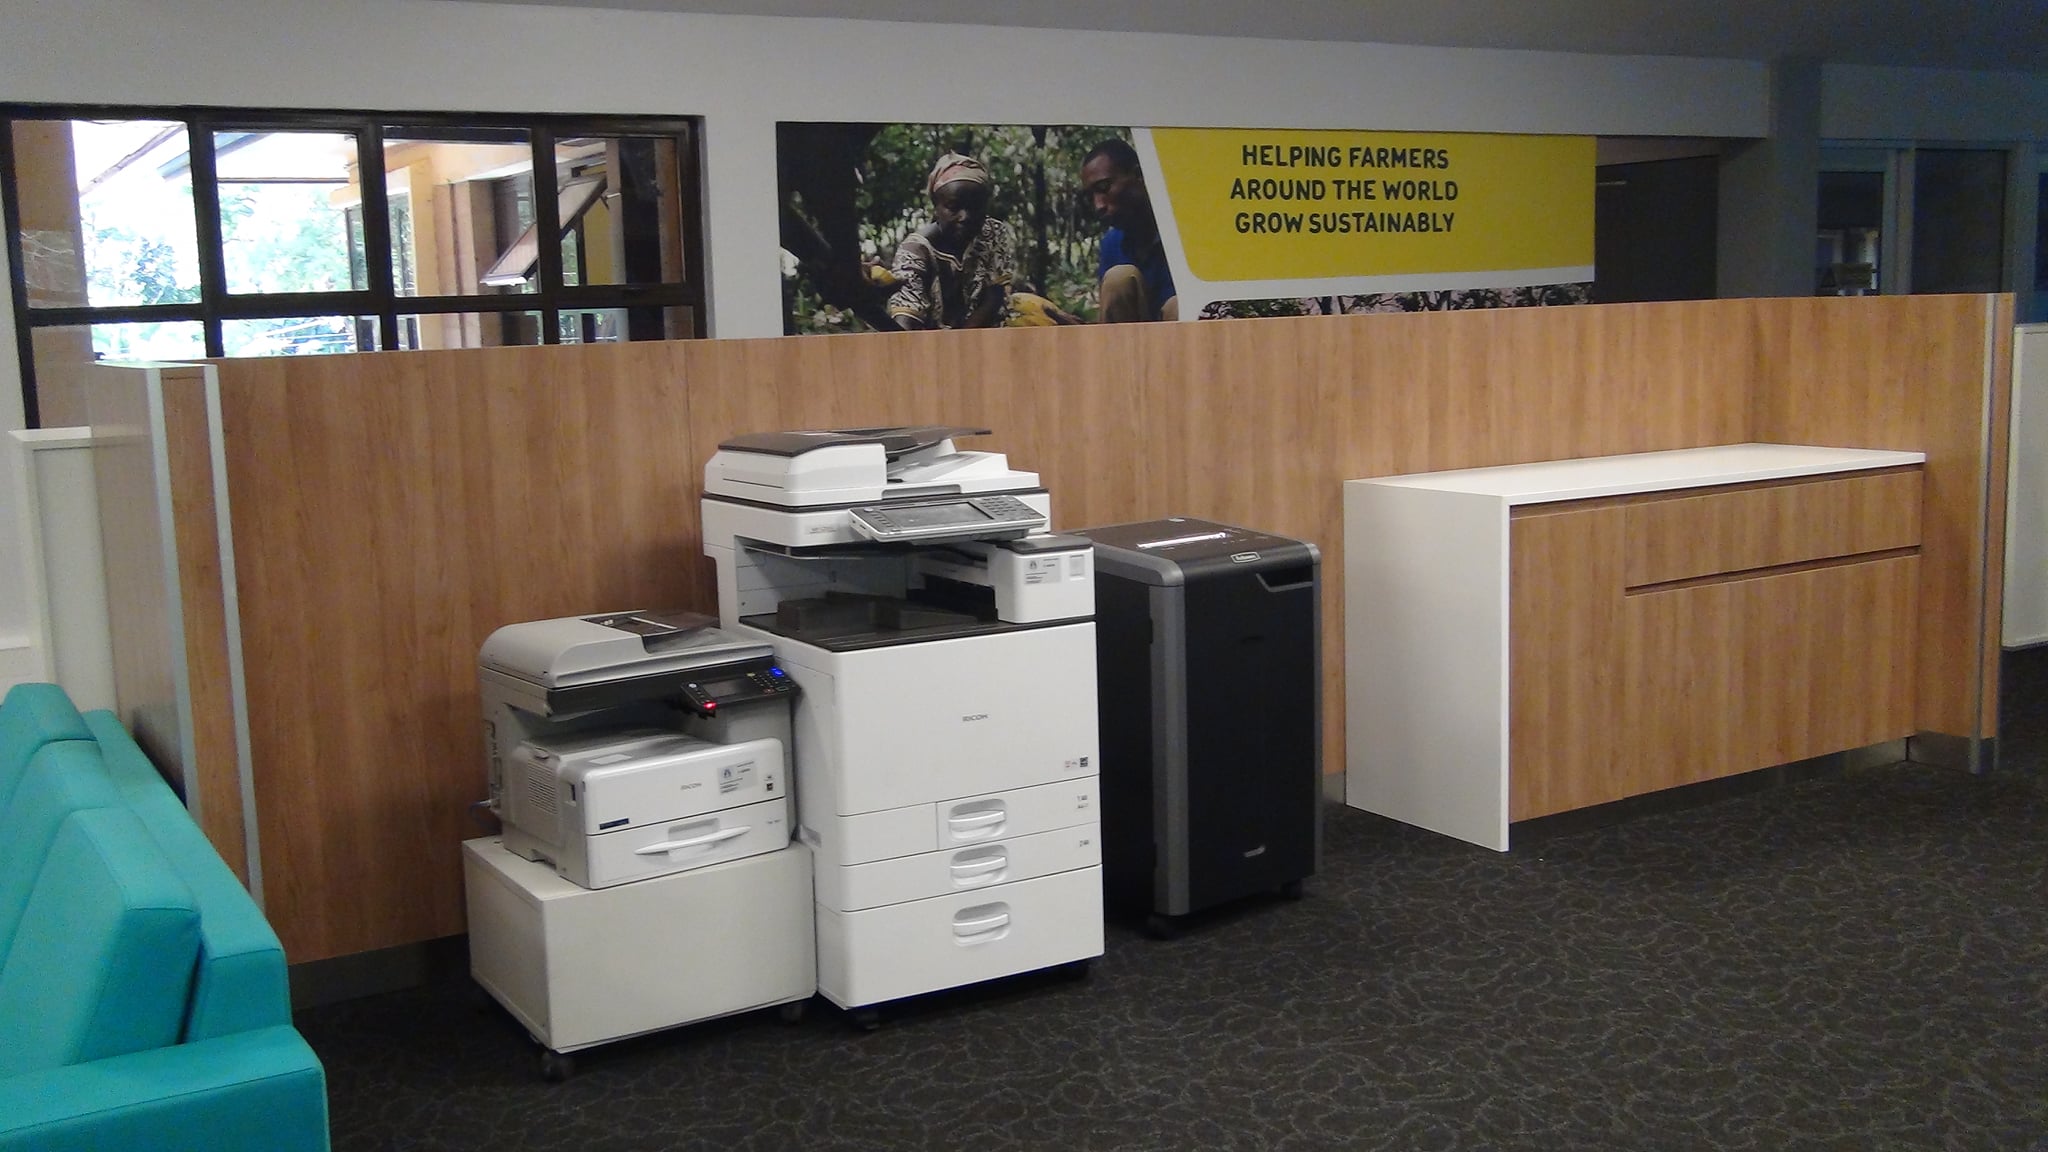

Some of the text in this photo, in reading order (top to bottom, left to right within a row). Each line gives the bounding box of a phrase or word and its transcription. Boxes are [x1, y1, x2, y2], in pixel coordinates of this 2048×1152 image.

[1242, 145, 1449, 169] HELPING FARMERS
[1230, 178, 1458, 200] AROUND THE WORLD
[1235, 212, 1454, 233] GROW SUSTAINABLY
